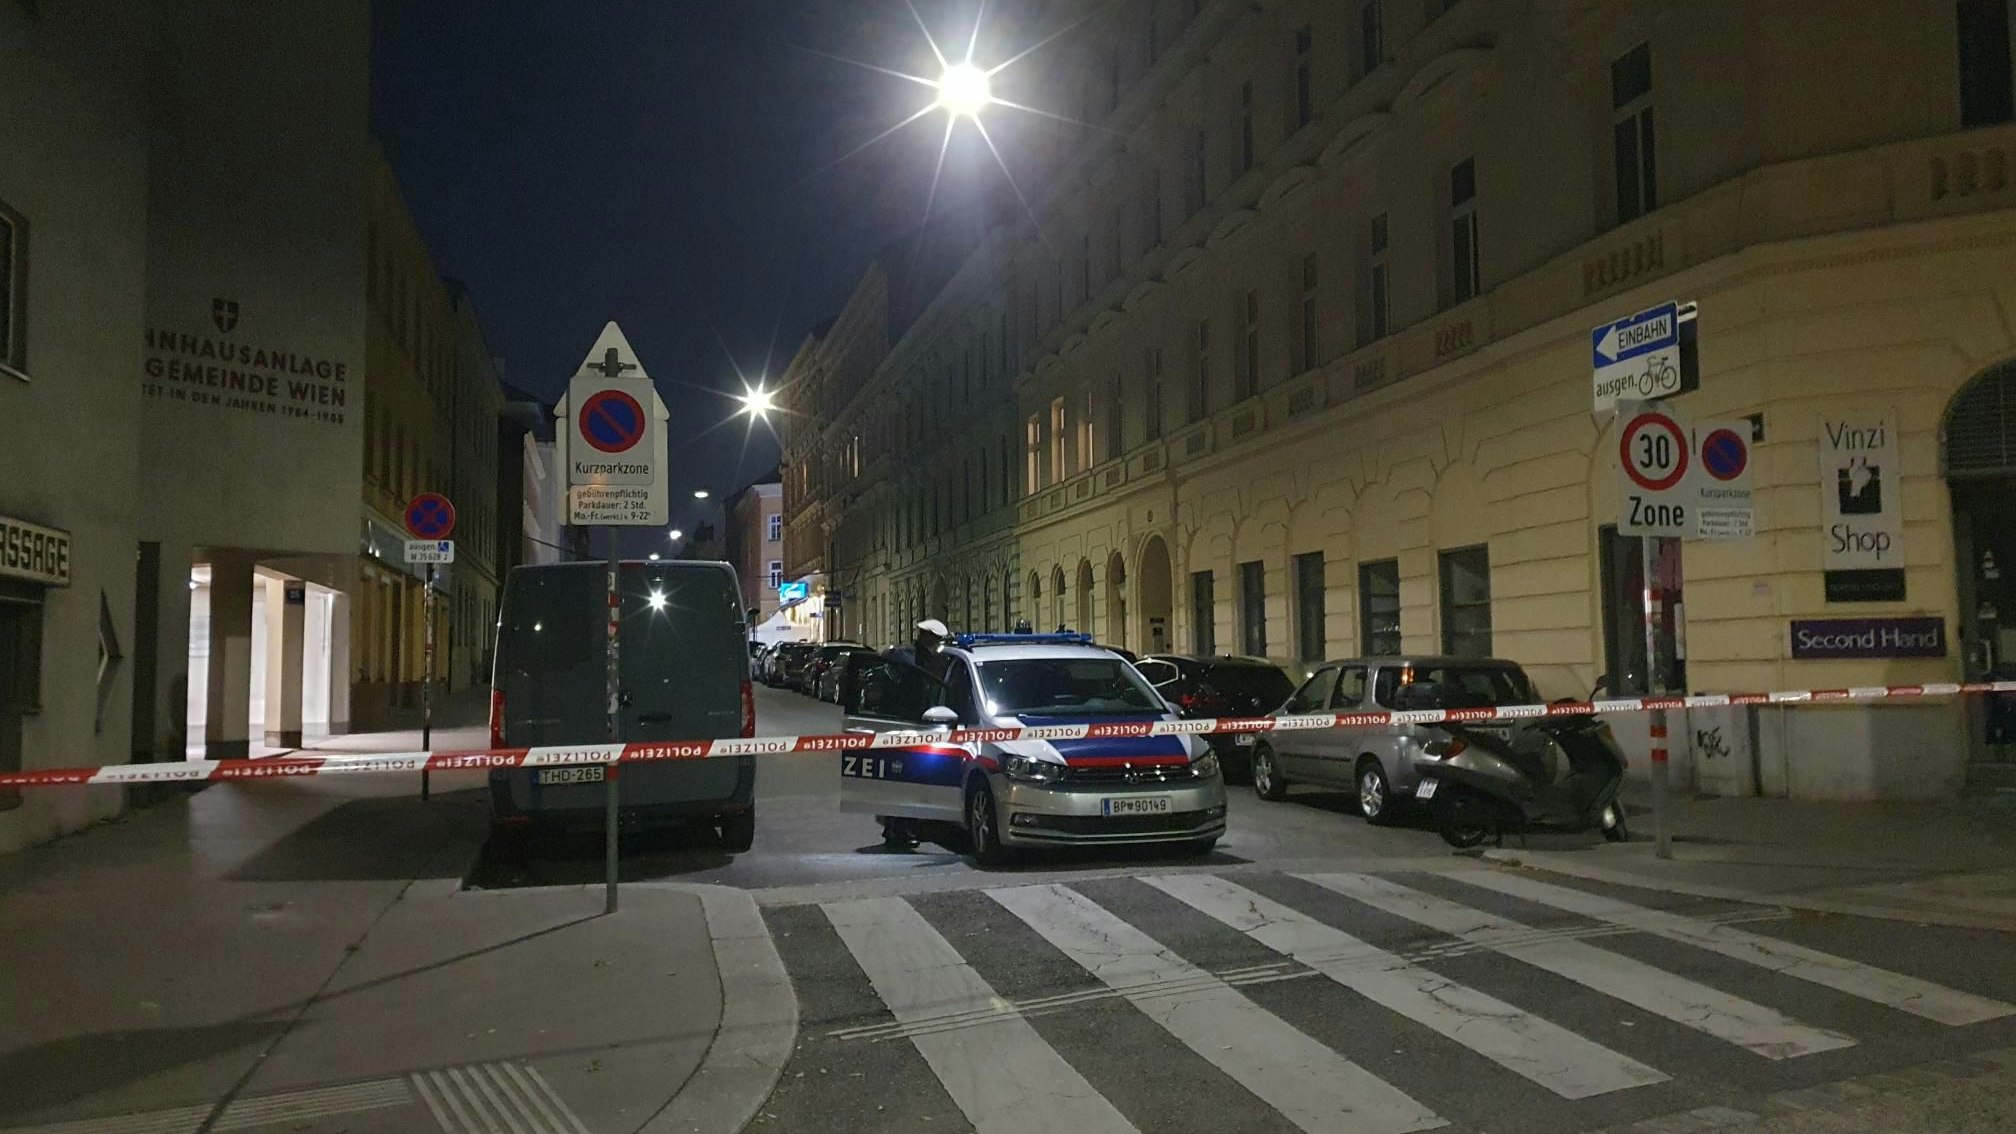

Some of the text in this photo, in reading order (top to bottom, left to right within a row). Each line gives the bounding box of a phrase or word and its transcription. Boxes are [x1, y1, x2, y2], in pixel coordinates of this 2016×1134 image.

[1618, 318, 1668, 349] EINBAHN
[145, 357, 346, 407] GEMEINDE WIEN
[1596, 374, 1638, 397] ausgen.
[1825, 421, 1886, 451] Vinzi
[1639, 433, 1670, 470] 30
[575, 462, 649, 476] Kurzparkzone
[624, 501, 629, 509] 2
[630, 500, 647, 509] Std.
[1628, 496, 1685, 527] Zone
[1831, 524, 1891, 561] Shop
[1798, 627, 1938, 650] Second Hand
[1289, 718, 1330, 728] POLIZEI
[1347, 716, 1386, 726] POLIZEI
[1034, 727, 1082, 740] POLIZEI
[1101, 724, 1148, 737] POLIZEI
[1166, 722, 1210, 734] POLIZEI
[811, 737, 866, 749] POLIZEI
[889, 733, 942, 747] POLIZEI
[964, 730, 1013, 743] POLIZEI
[639, 746, 702, 759] POLIZEI
[728, 742, 787, 755] POLIZEI
[446, 755, 516, 768] POLIZEI
[546, 751, 611, 764] POLIZEI
[843, 756, 885, 779] ZEI
[542, 767, 601, 783] THD-265
[1112, 800, 1167, 813] BP 90149
